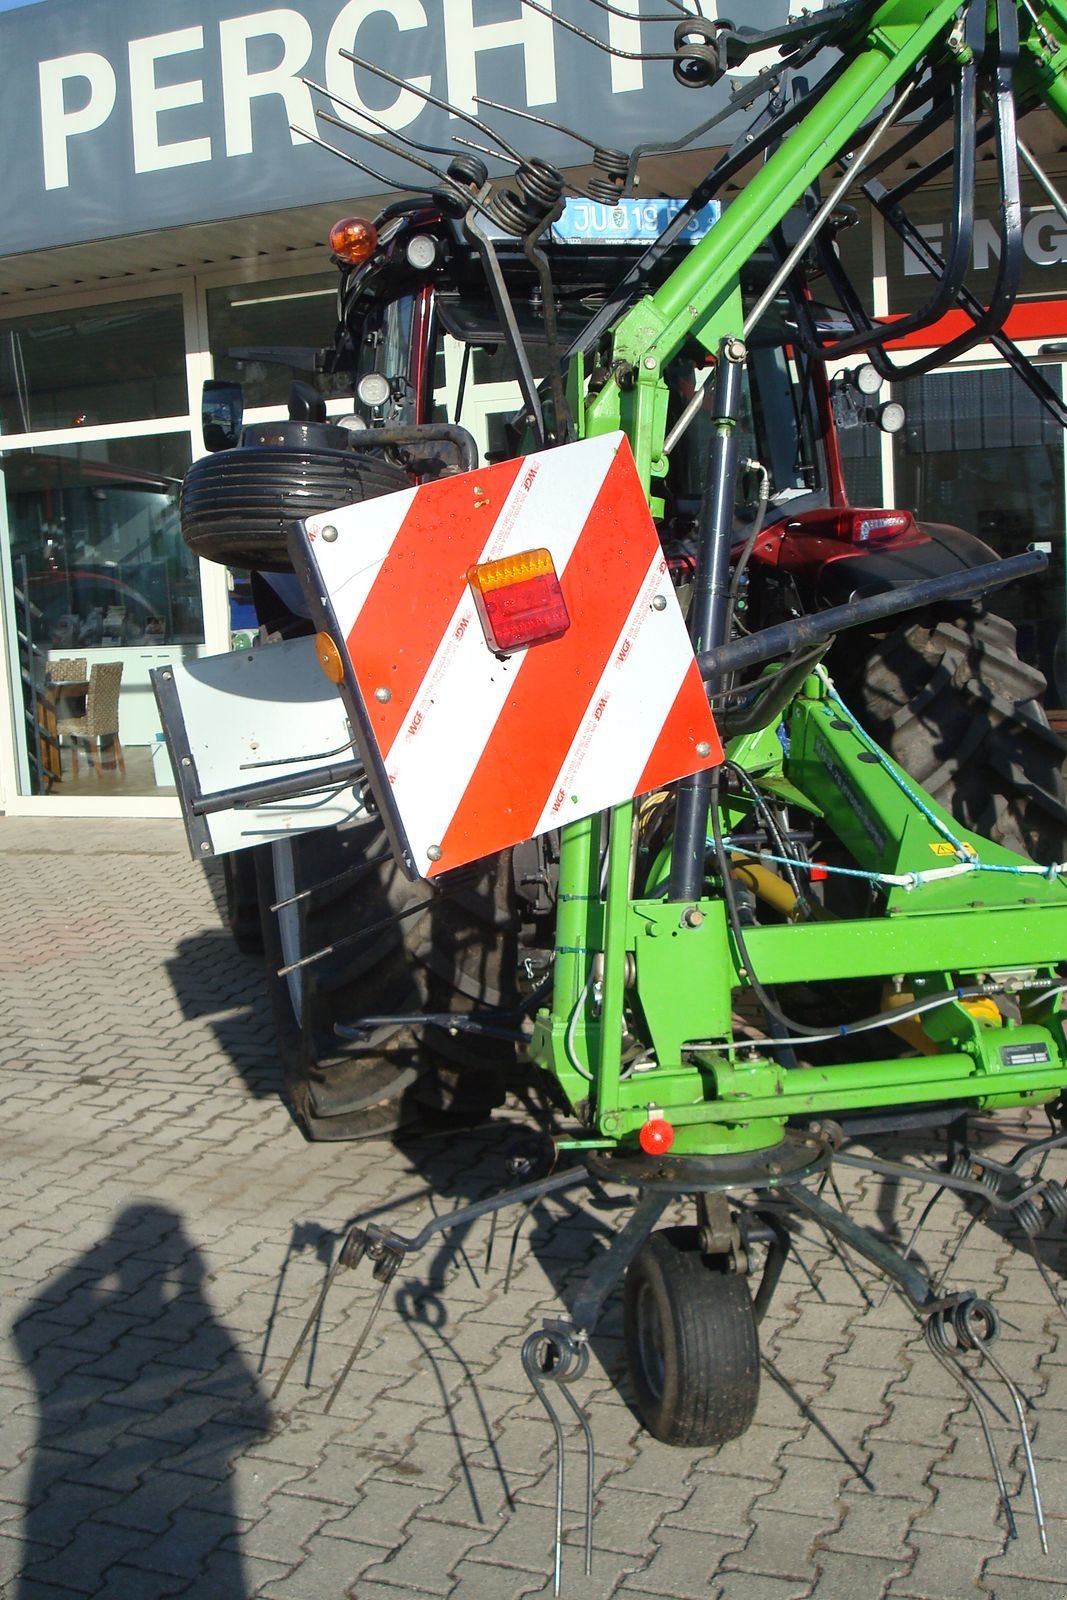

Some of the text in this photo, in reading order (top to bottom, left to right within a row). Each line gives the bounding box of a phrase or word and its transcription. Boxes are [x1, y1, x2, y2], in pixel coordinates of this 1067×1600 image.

[574, 206, 608, 232] JU
[632, 206, 657, 232] 19
[407, 710, 424, 735] WGF
[551, 788, 567, 812] WGF
